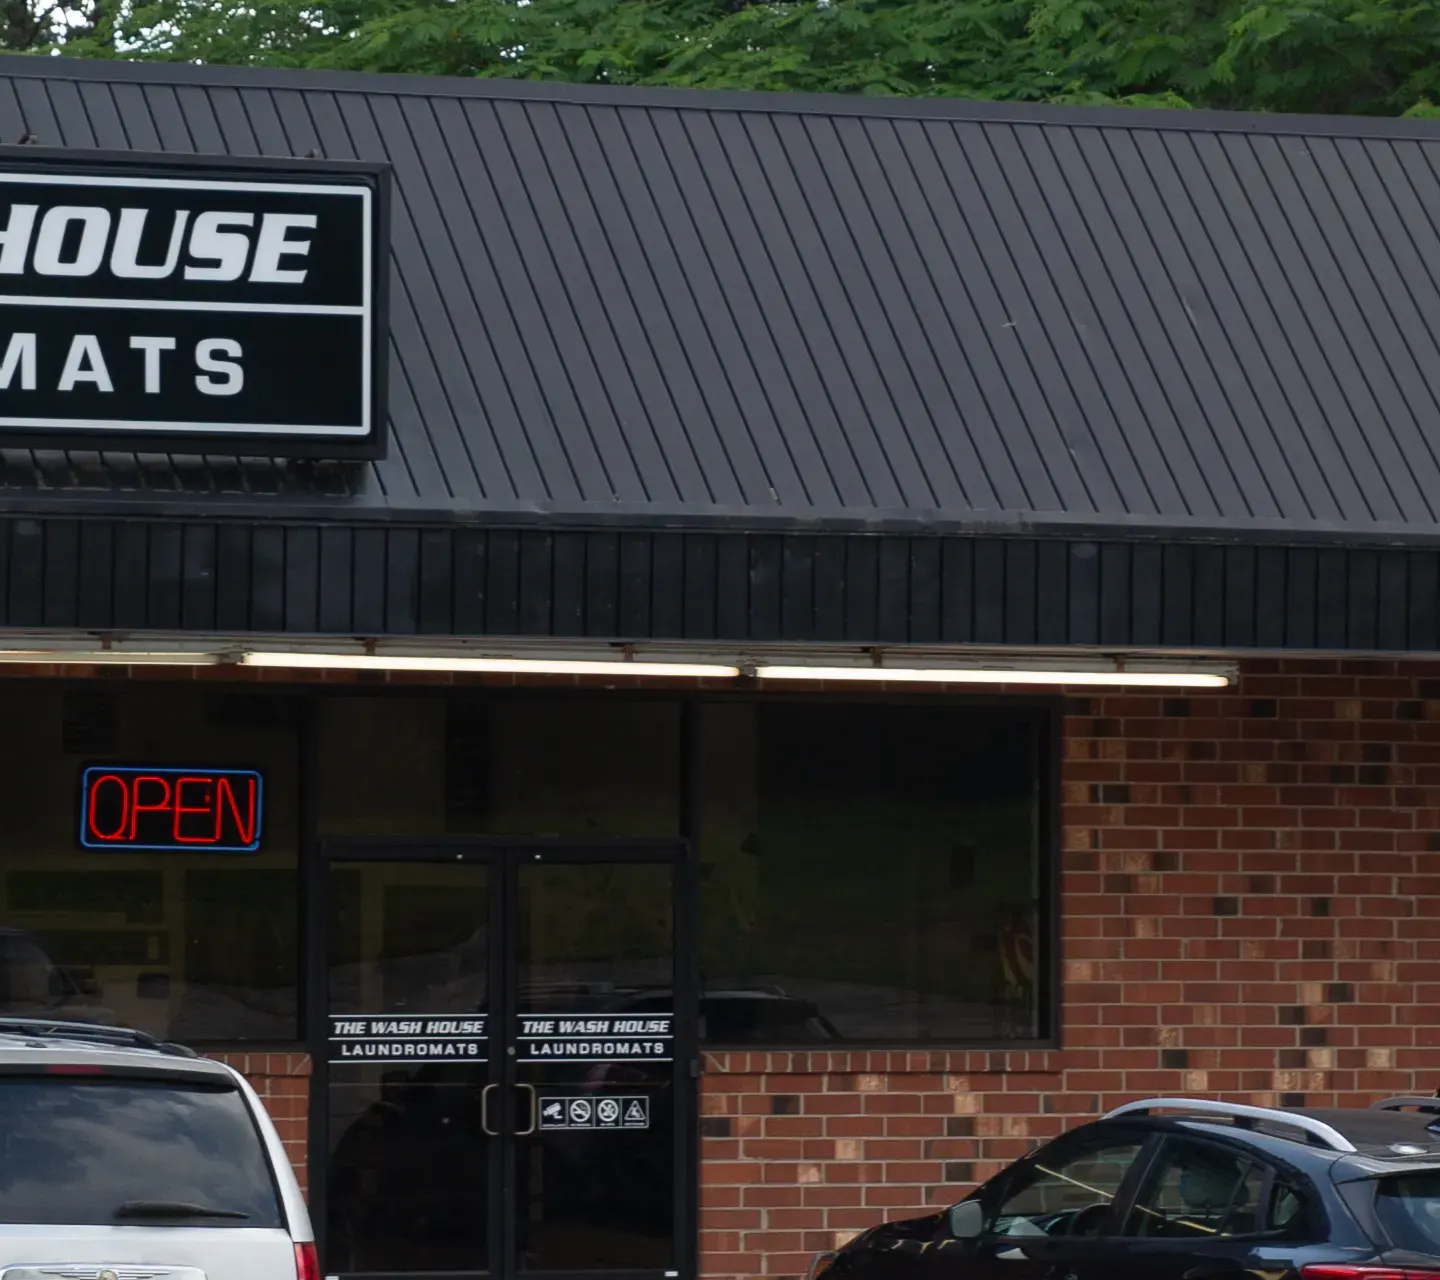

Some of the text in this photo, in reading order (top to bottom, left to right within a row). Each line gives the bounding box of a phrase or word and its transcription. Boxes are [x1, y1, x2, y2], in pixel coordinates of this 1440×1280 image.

[88, 775, 256, 844] OPEN
[334, 1021, 485, 1035] THE WASH HOUSE
[523, 1020, 670, 1034] THE WASH HOUSE
[341, 1043, 478, 1056] LAUNDROMATS
[530, 1042, 665, 1055] LAUNDROMATS
